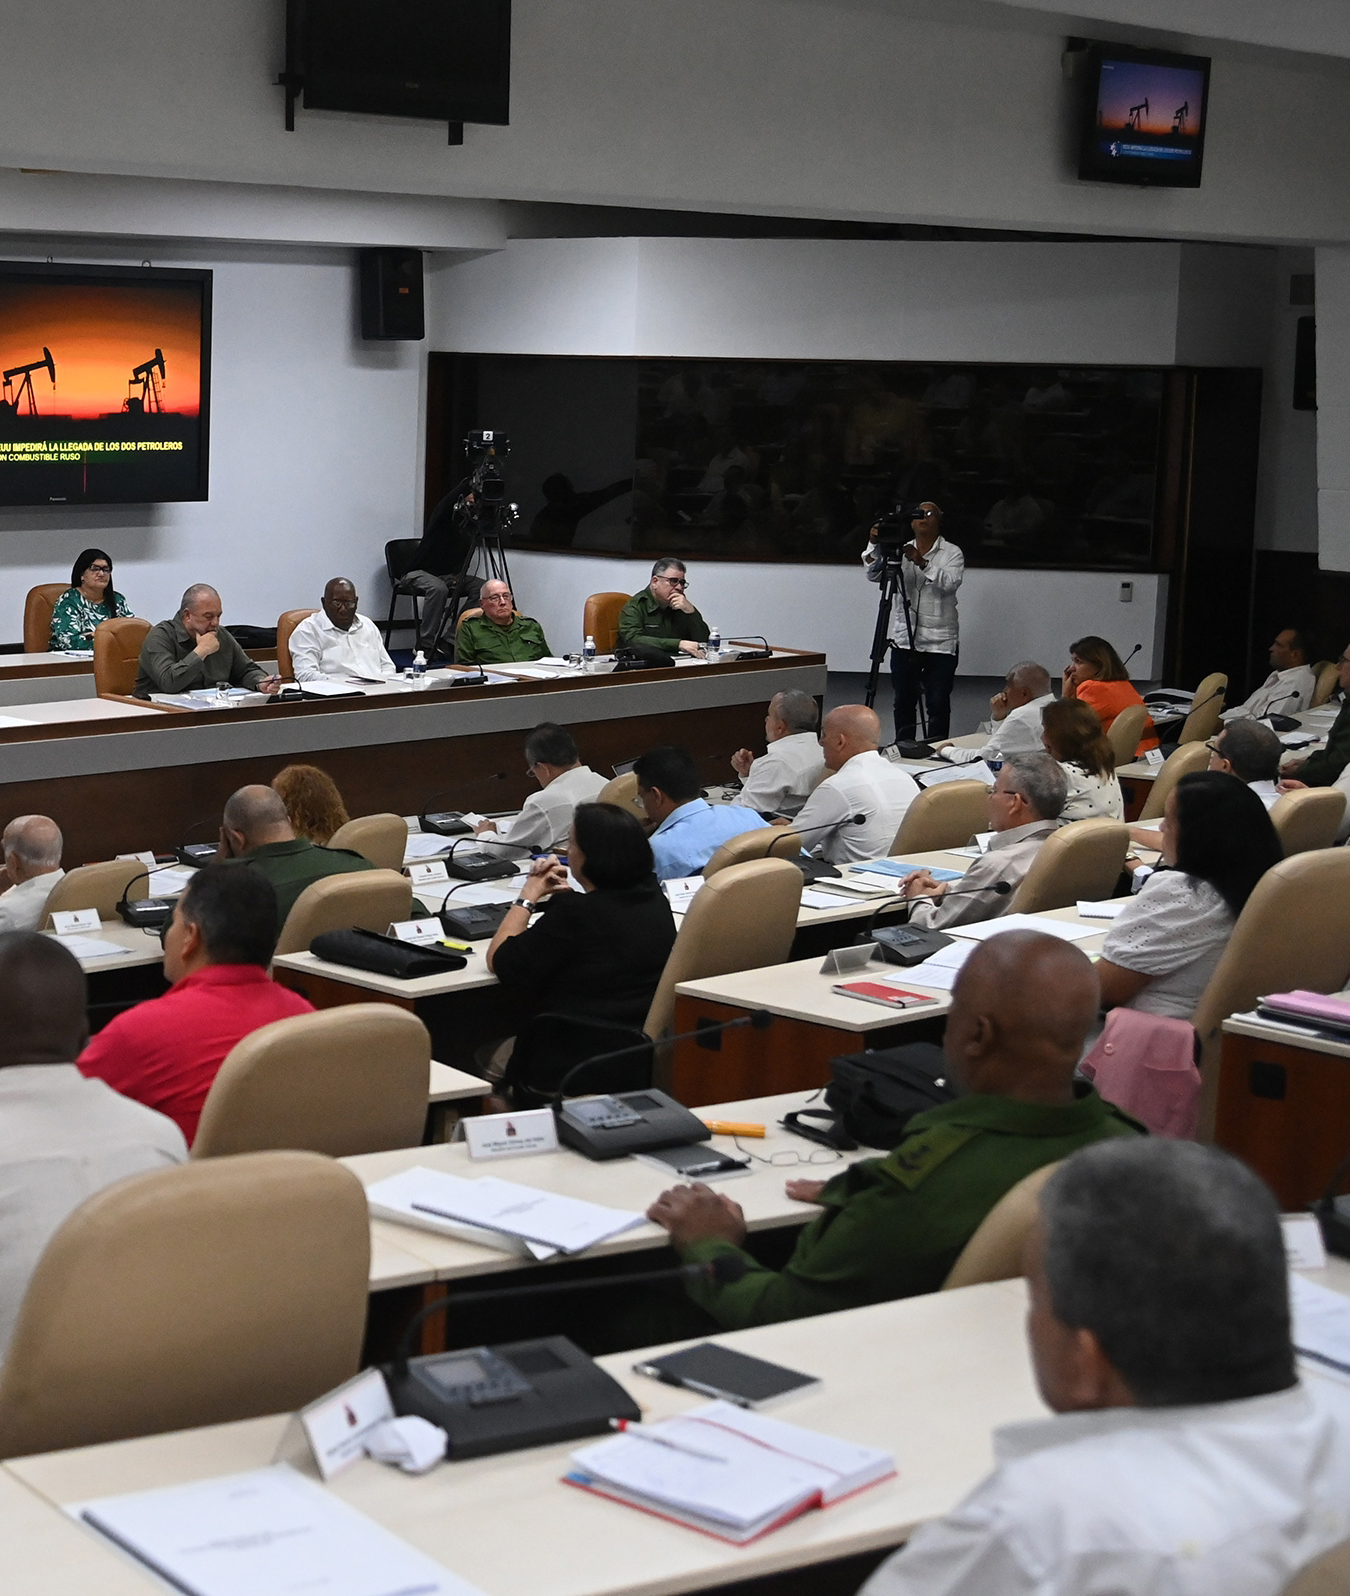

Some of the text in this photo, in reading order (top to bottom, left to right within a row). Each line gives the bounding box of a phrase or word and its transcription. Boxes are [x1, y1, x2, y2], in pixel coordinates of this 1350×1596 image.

[12, 440, 48, 452] IMPEDIRÁ
[48, 442, 59, 452] LA
[59, 442, 94, 452] LLEGADA
[93, 442, 105, 452] DE
[105, 442, 120, 451] LOS
[120, 441, 136, 451] DOS
[136, 441, 183, 451] PETROLEROS
[7, 453, 59, 462] COMBUSTIBLE
[59, 452, 81, 461] RUSO
